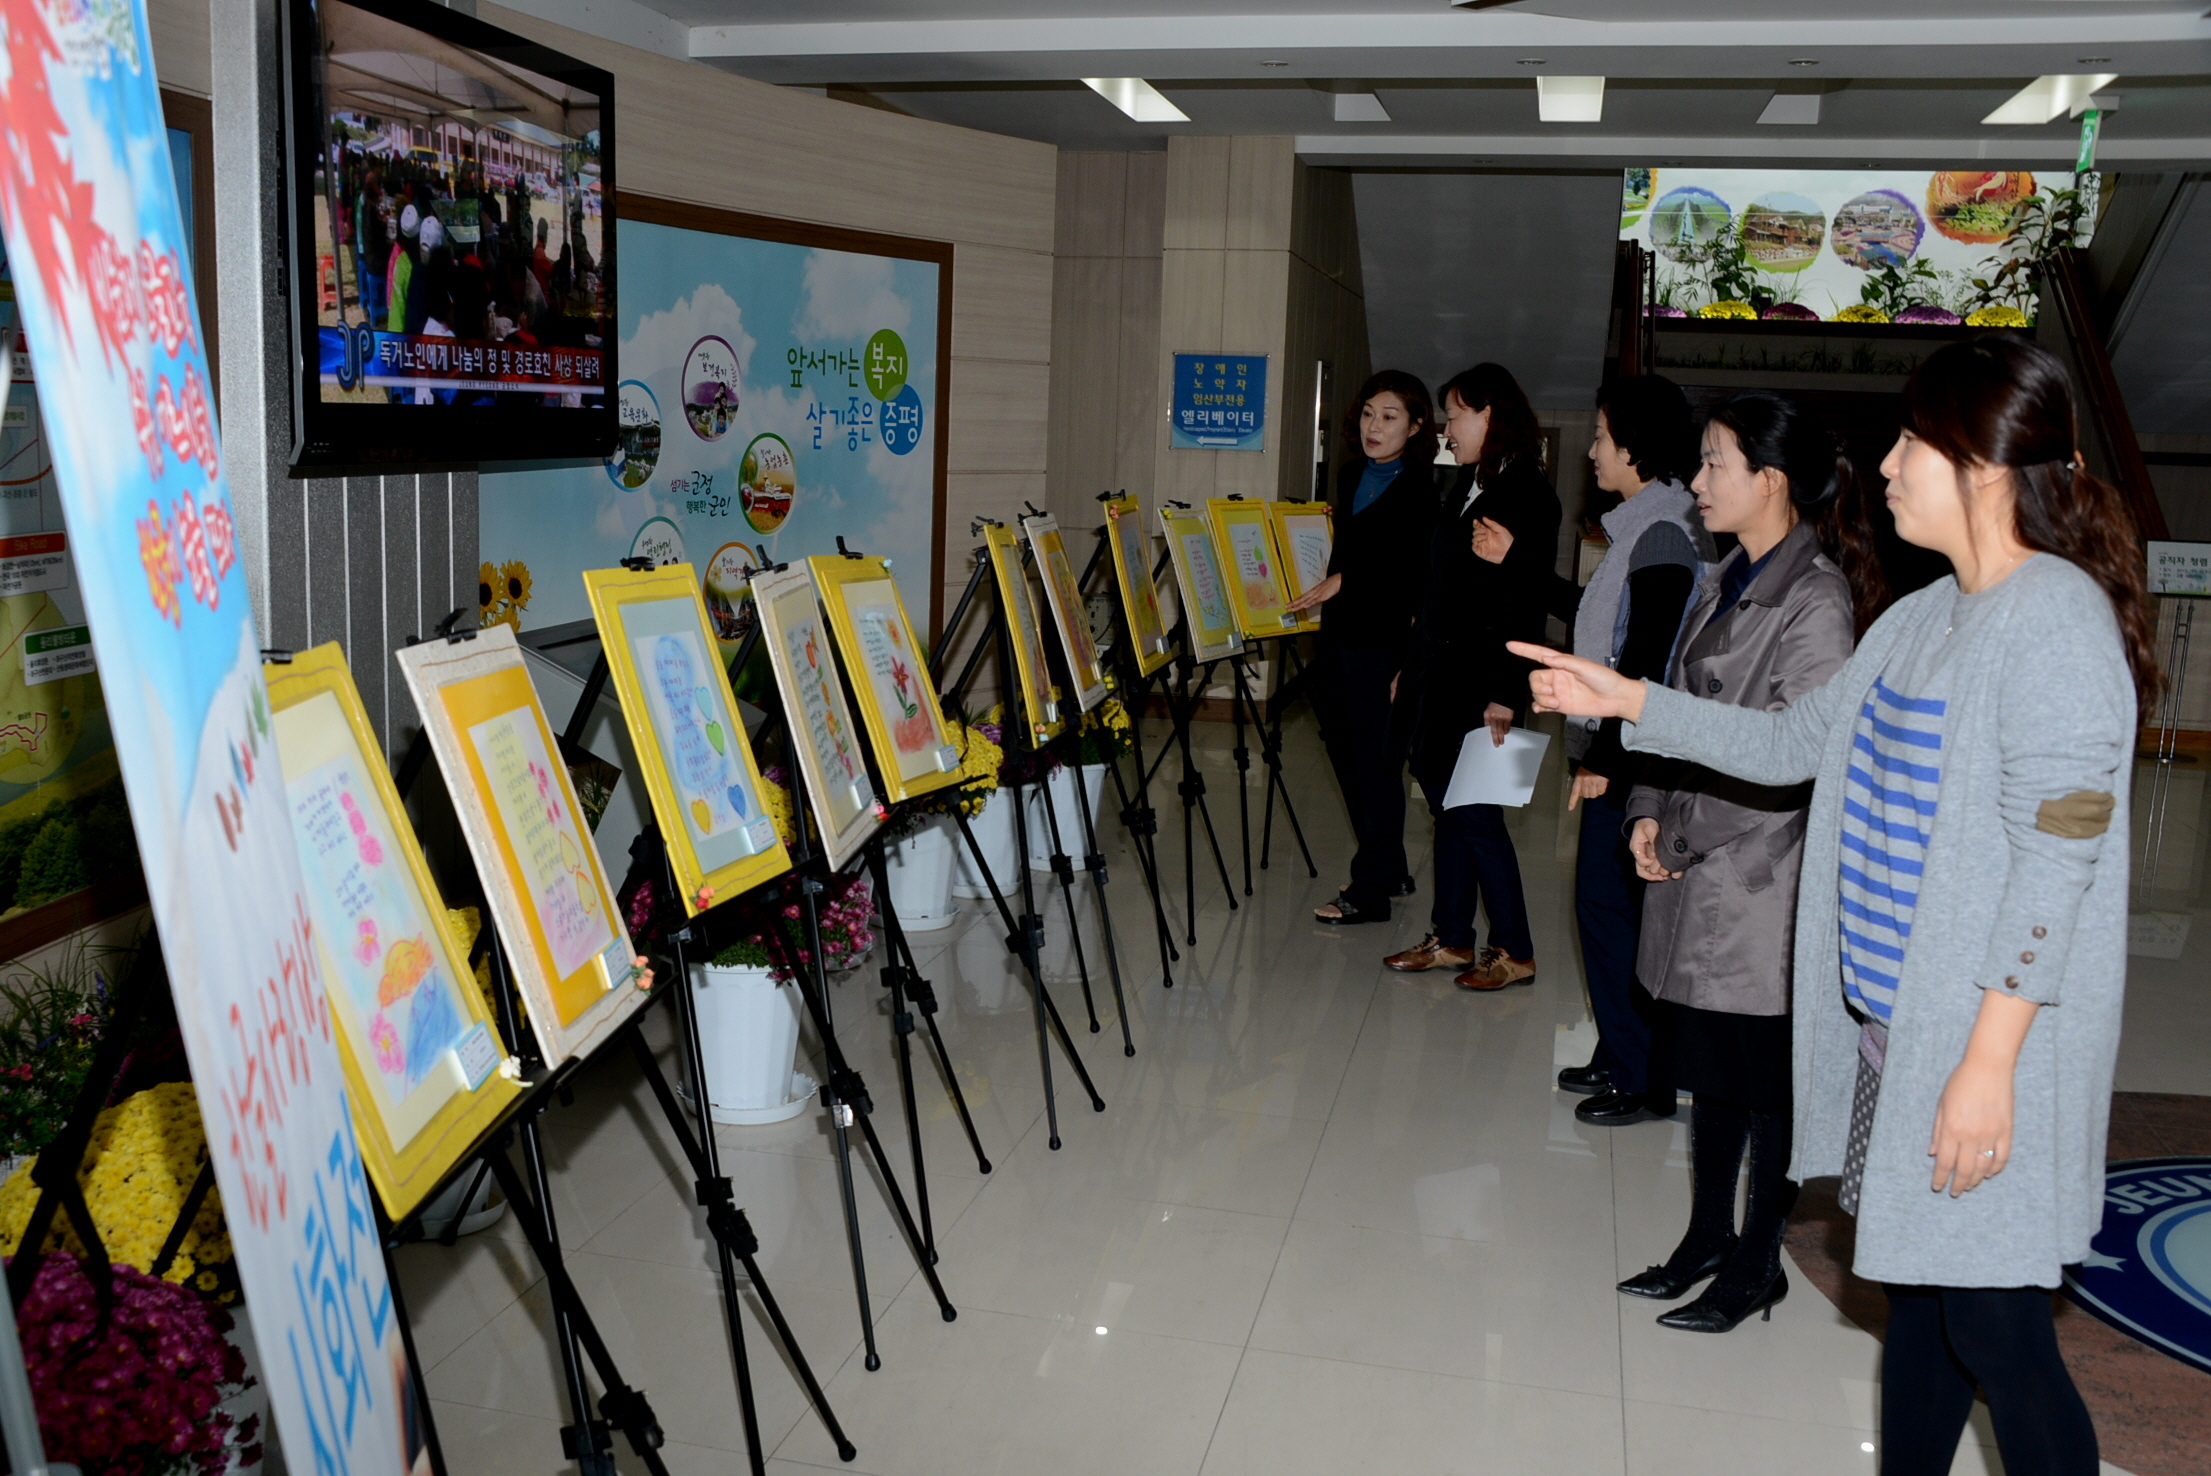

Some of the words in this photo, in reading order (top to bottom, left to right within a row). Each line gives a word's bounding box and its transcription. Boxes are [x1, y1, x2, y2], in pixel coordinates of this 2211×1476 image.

[379, 340, 449, 371] 독거노인에게
[451, 345, 484, 373] 나눔의
[486, 350, 497, 375] 정
[501, 350, 512, 375] 및
[514, 351, 552, 377] 경로효친
[554, 354, 573, 379] 사상
[574, 356, 601, 380] 되살려
[787, 347, 860, 388] 앞서가는
[870, 343, 904, 390] 복지
[805, 396, 875, 452] 살기좋은
[884, 400, 919, 446] 증평
[1181, 409, 1254, 426] 엘리베이터
[670, 479, 690, 492] 섬기는
[691, 470, 714, 496] 군정
[686, 500, 707, 514] 행복한
[708, 495, 731, 517] 군민
